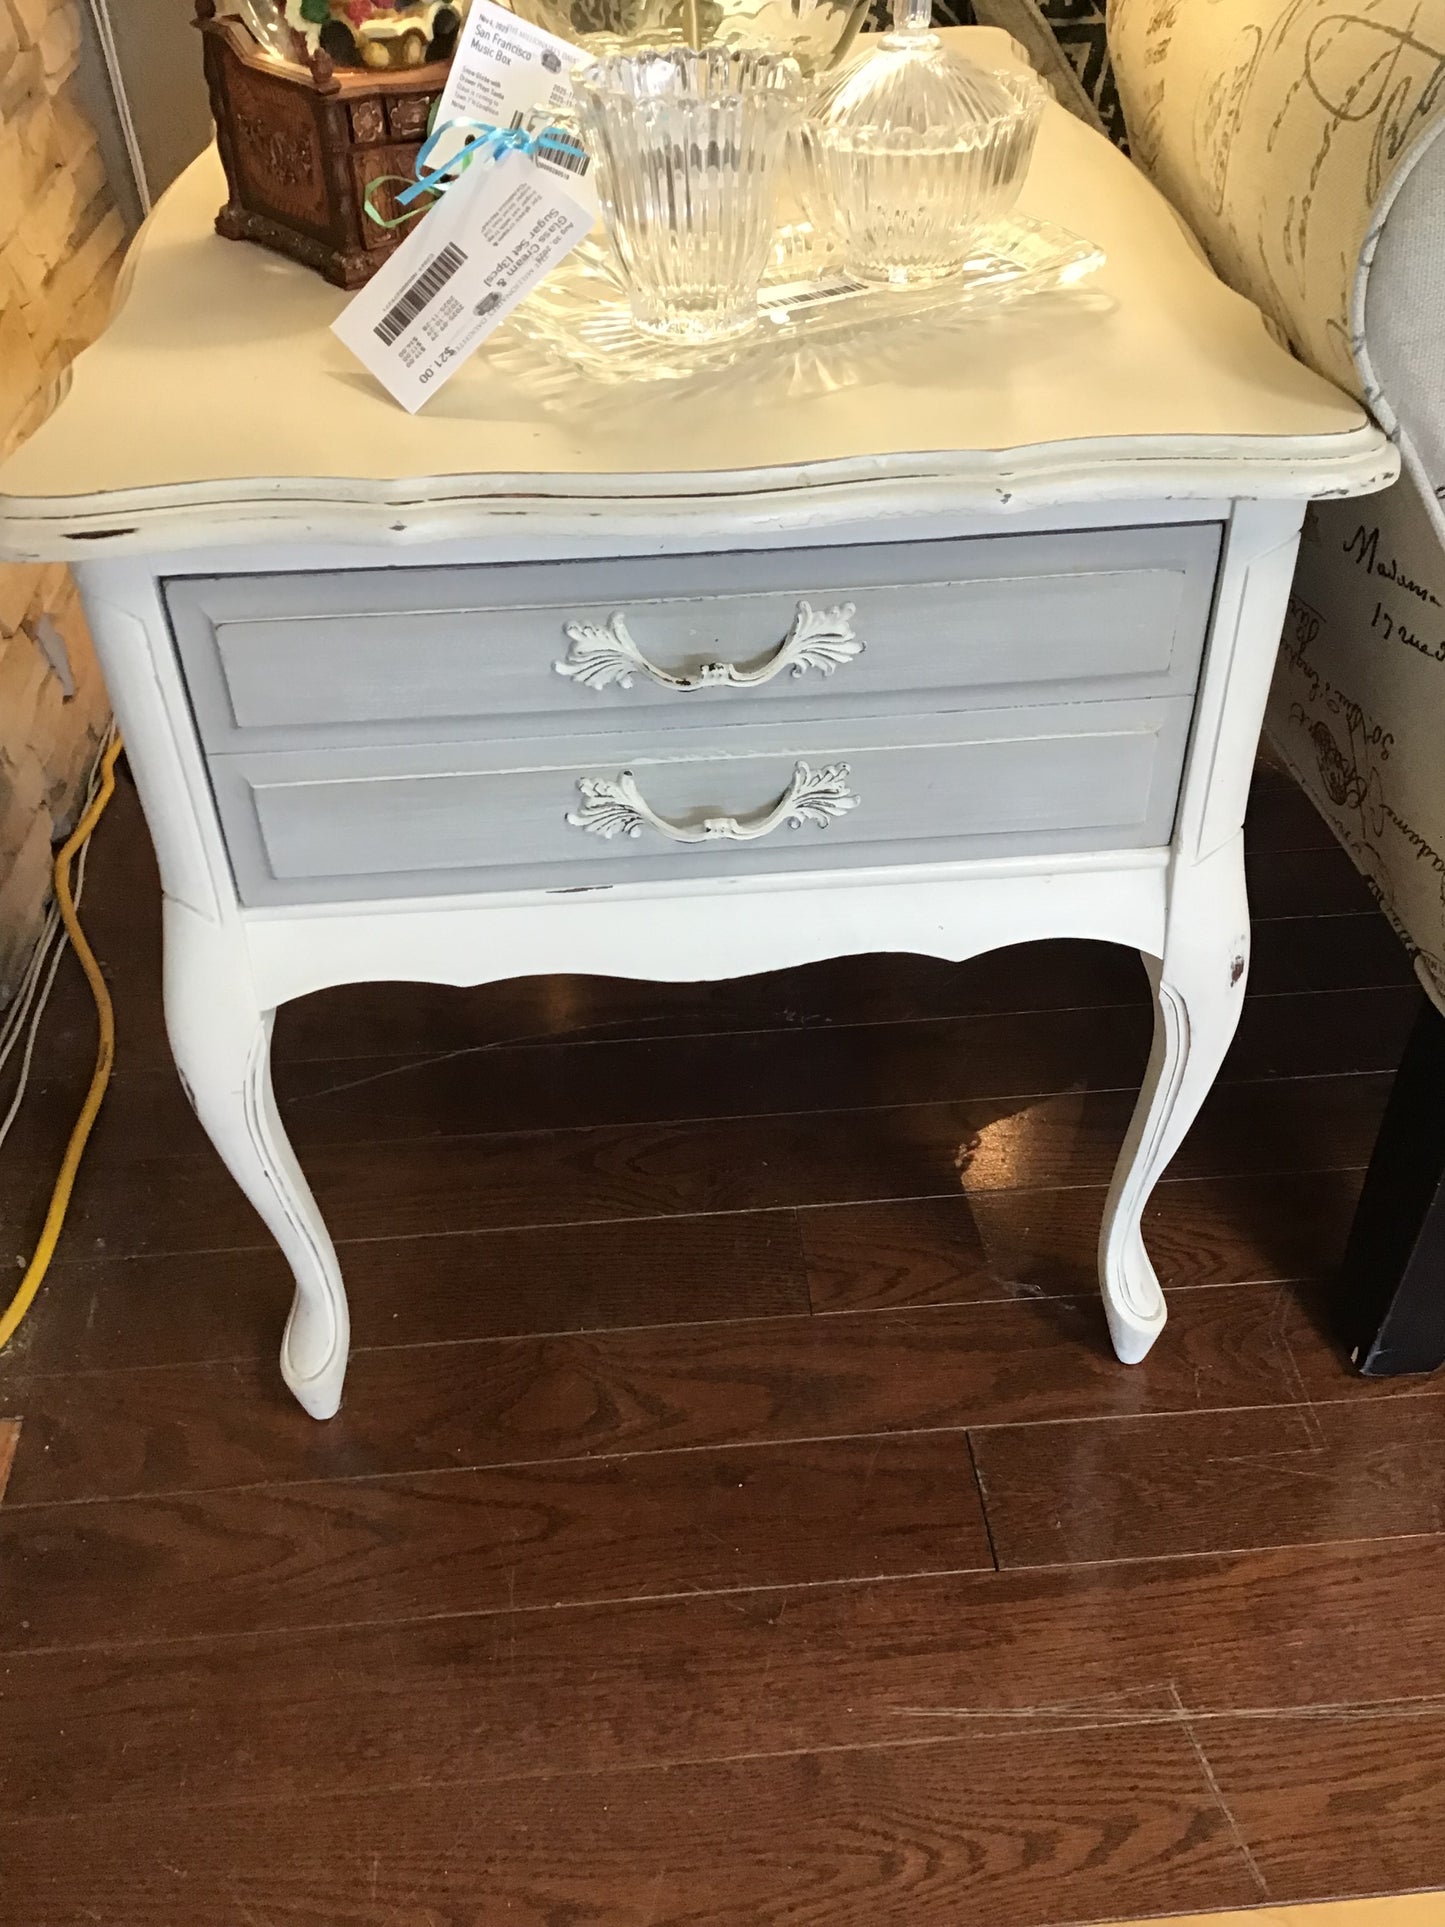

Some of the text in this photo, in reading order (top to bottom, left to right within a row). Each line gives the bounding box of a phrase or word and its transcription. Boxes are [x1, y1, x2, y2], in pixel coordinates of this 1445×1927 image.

[470, 37, 512, 66] Music Box
[474, 23, 532, 61] San Francisco
[481, 205, 560, 288] Sugar Set (3pcs)
[559, 220, 574, 236] Aug
[495, 213, 568, 289] Glass Cream &
[416, 344, 456, 385] $21.00
